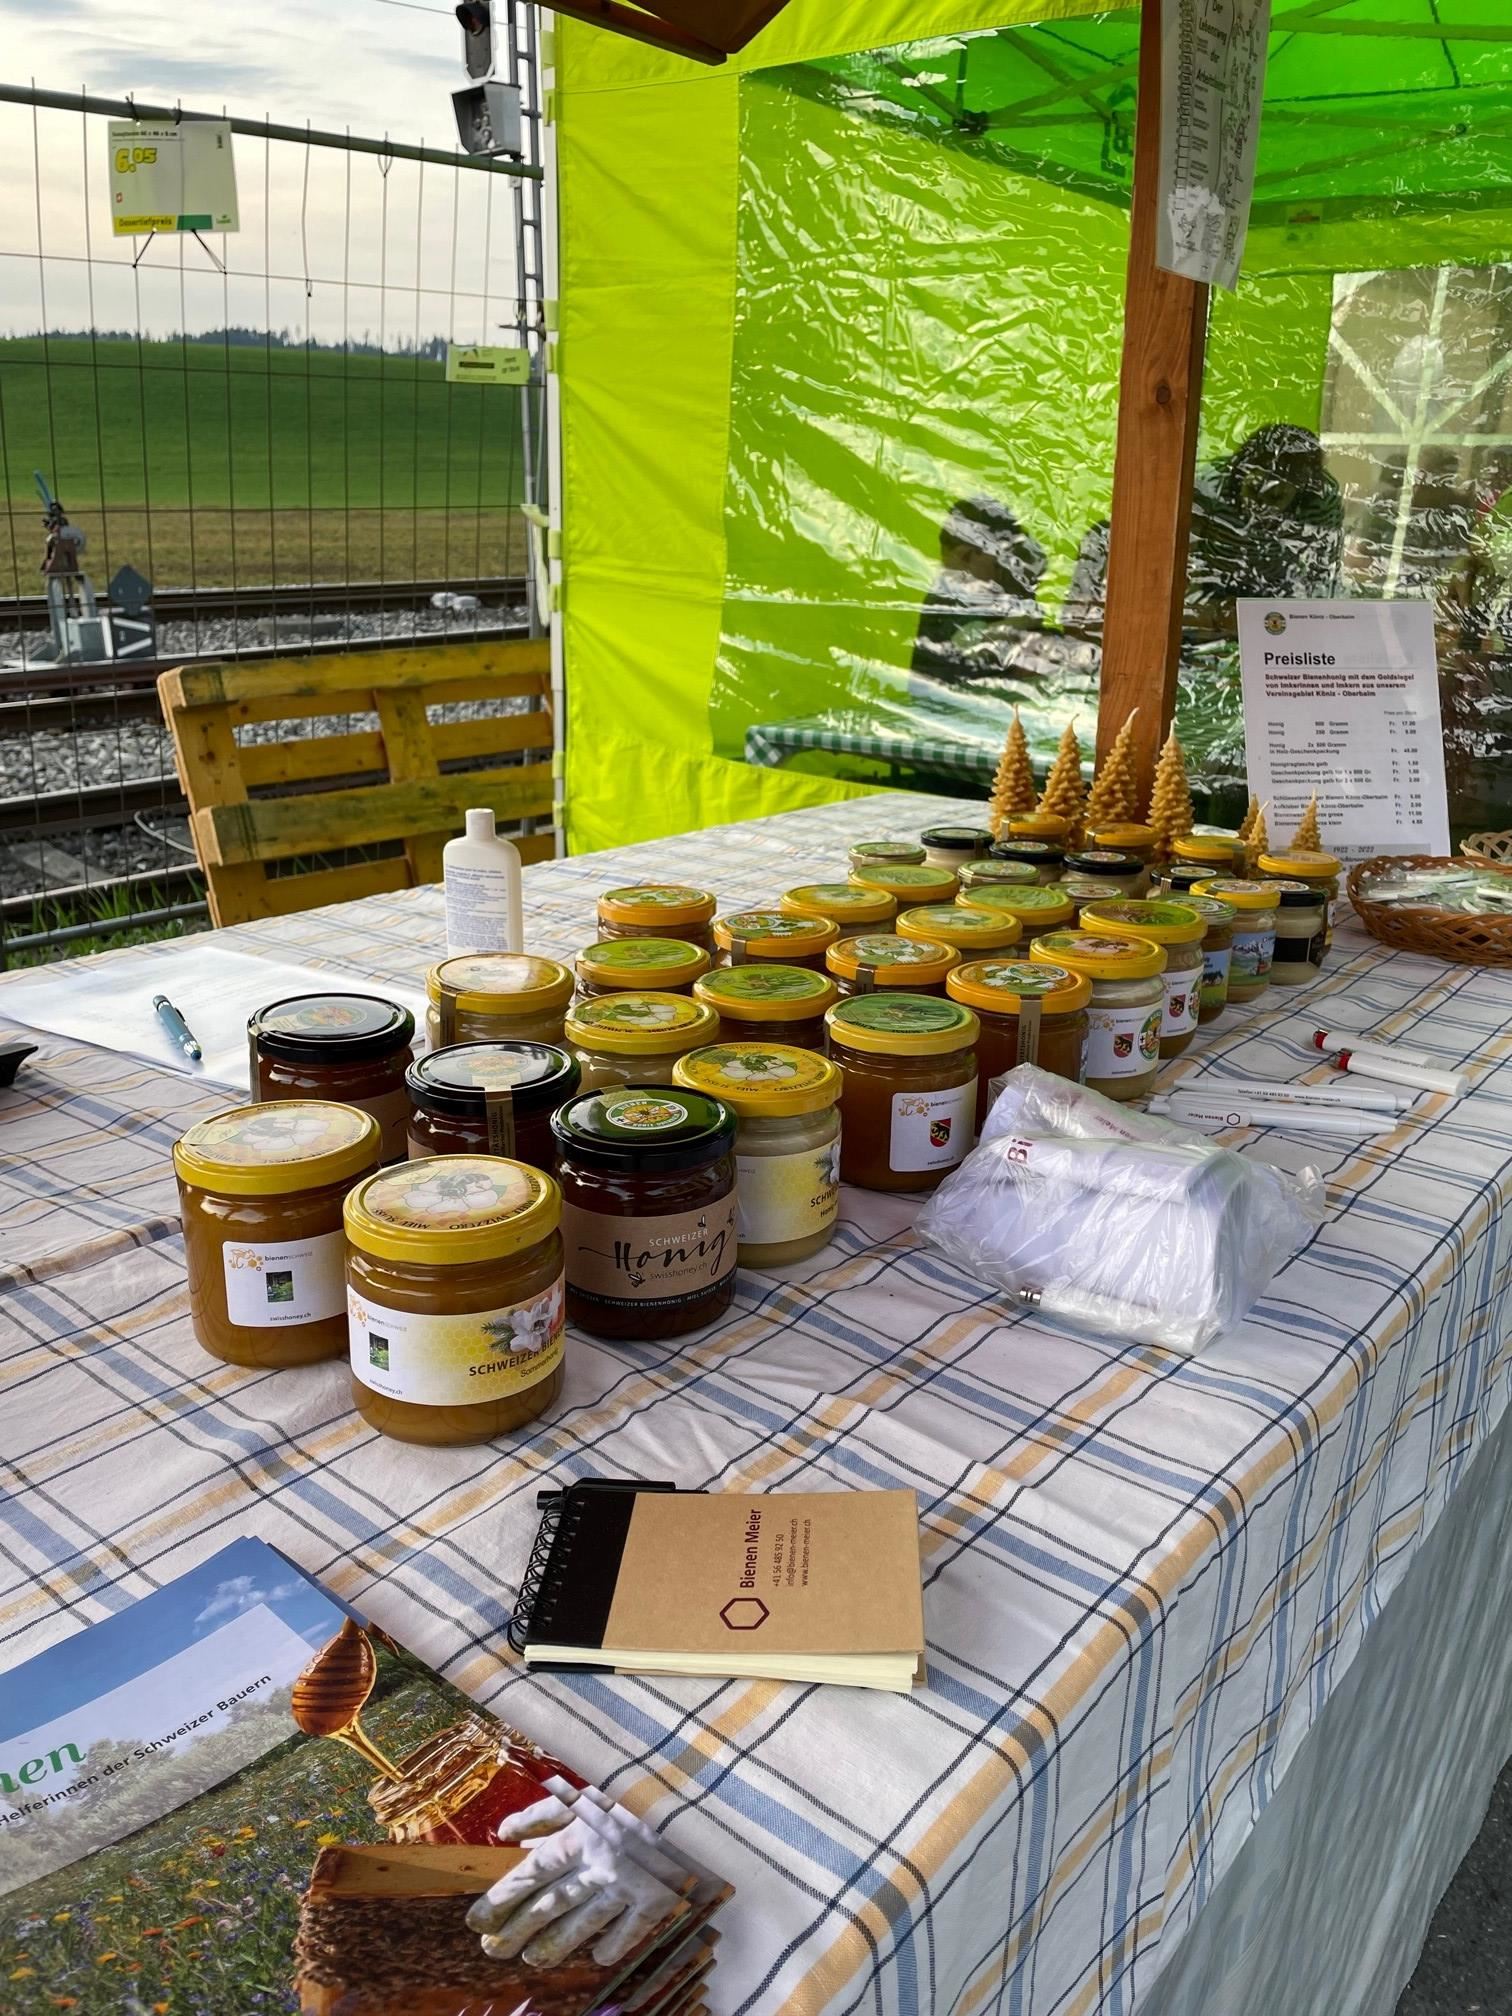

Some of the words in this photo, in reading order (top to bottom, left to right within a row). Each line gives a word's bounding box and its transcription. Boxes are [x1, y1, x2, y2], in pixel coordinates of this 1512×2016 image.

[115, 147, 158, 173] 6.05
[118, 217, 172, 227] Dauertiefpreis
[1264, 652, 1336, 666] Preisliste
[1265, 673, 1301, 681] Schweizer
[1303, 673, 1347, 682] Bienenhonig
[1348, 673, 1360, 681] mit
[1361, 673, 1376, 681] dem
[1377, 673, 1415, 682] Goldsiegel
[1266, 690, 1314, 698] Vereinsgebiet
[1007, 1138, 1033, 1164] Bi
[401, 1220, 431, 1231] MIEL
[649, 1229, 709, 1247] SCHWEIZER
[590, 1230, 727, 1277] Honig
[650, 1262, 708, 1280] swisshoney.ch
[604, 1299, 639, 1307] SCHWEIZER
[639, 1298, 682, 1307] BIENENHONIG
[270, 1312, 312, 1321] swisshoney.ch
[744, 1508, 762, 1543] Meier
[775, 1533, 785, 1542] 50
[774, 1543, 785, 1552] 92
[786, 1518, 799, 1587] info@bienen-meier.ch
[801, 1519, 812, 1586] www.bienen-meier.ch
[773, 1552, 784, 1563] 485
[739, 1545, 758, 1588] Bienen
[773, 1565, 783, 1574] 56
[772, 1574, 783, 1587] +41
[0, 1775, 99, 1825] Helferinnen
[102, 1758, 130, 1777] der
[133, 1709, 215, 1760] Schweizer
[217, 1673, 273, 1712] Bauern
